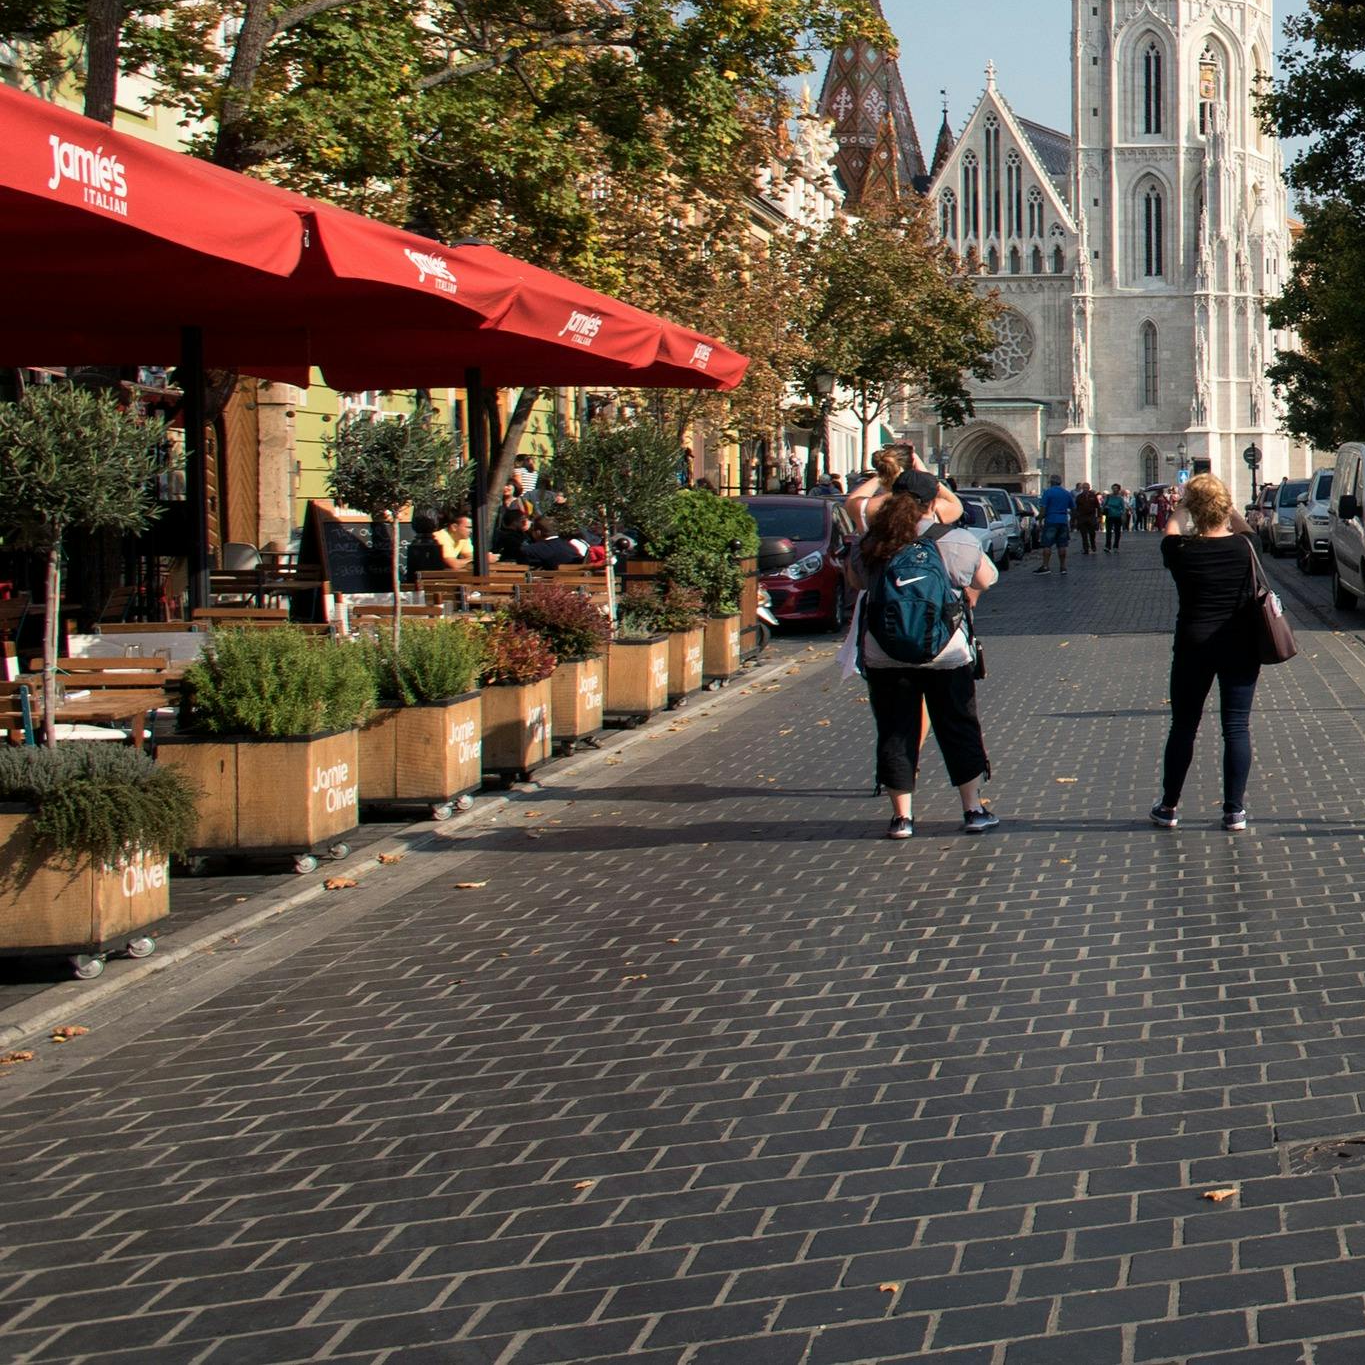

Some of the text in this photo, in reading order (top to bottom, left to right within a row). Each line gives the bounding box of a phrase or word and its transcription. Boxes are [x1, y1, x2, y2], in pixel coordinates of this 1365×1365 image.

[48, 134, 128, 198] Jamie's
[84, 187, 128, 216] ITALIAN
[448, 716, 474, 745] Jamie
[459, 739, 482, 763] Oliver
[312, 758, 348, 793] Jamie
[326, 784, 358, 813] Oliver
[123, 861, 170, 897] Oliver
